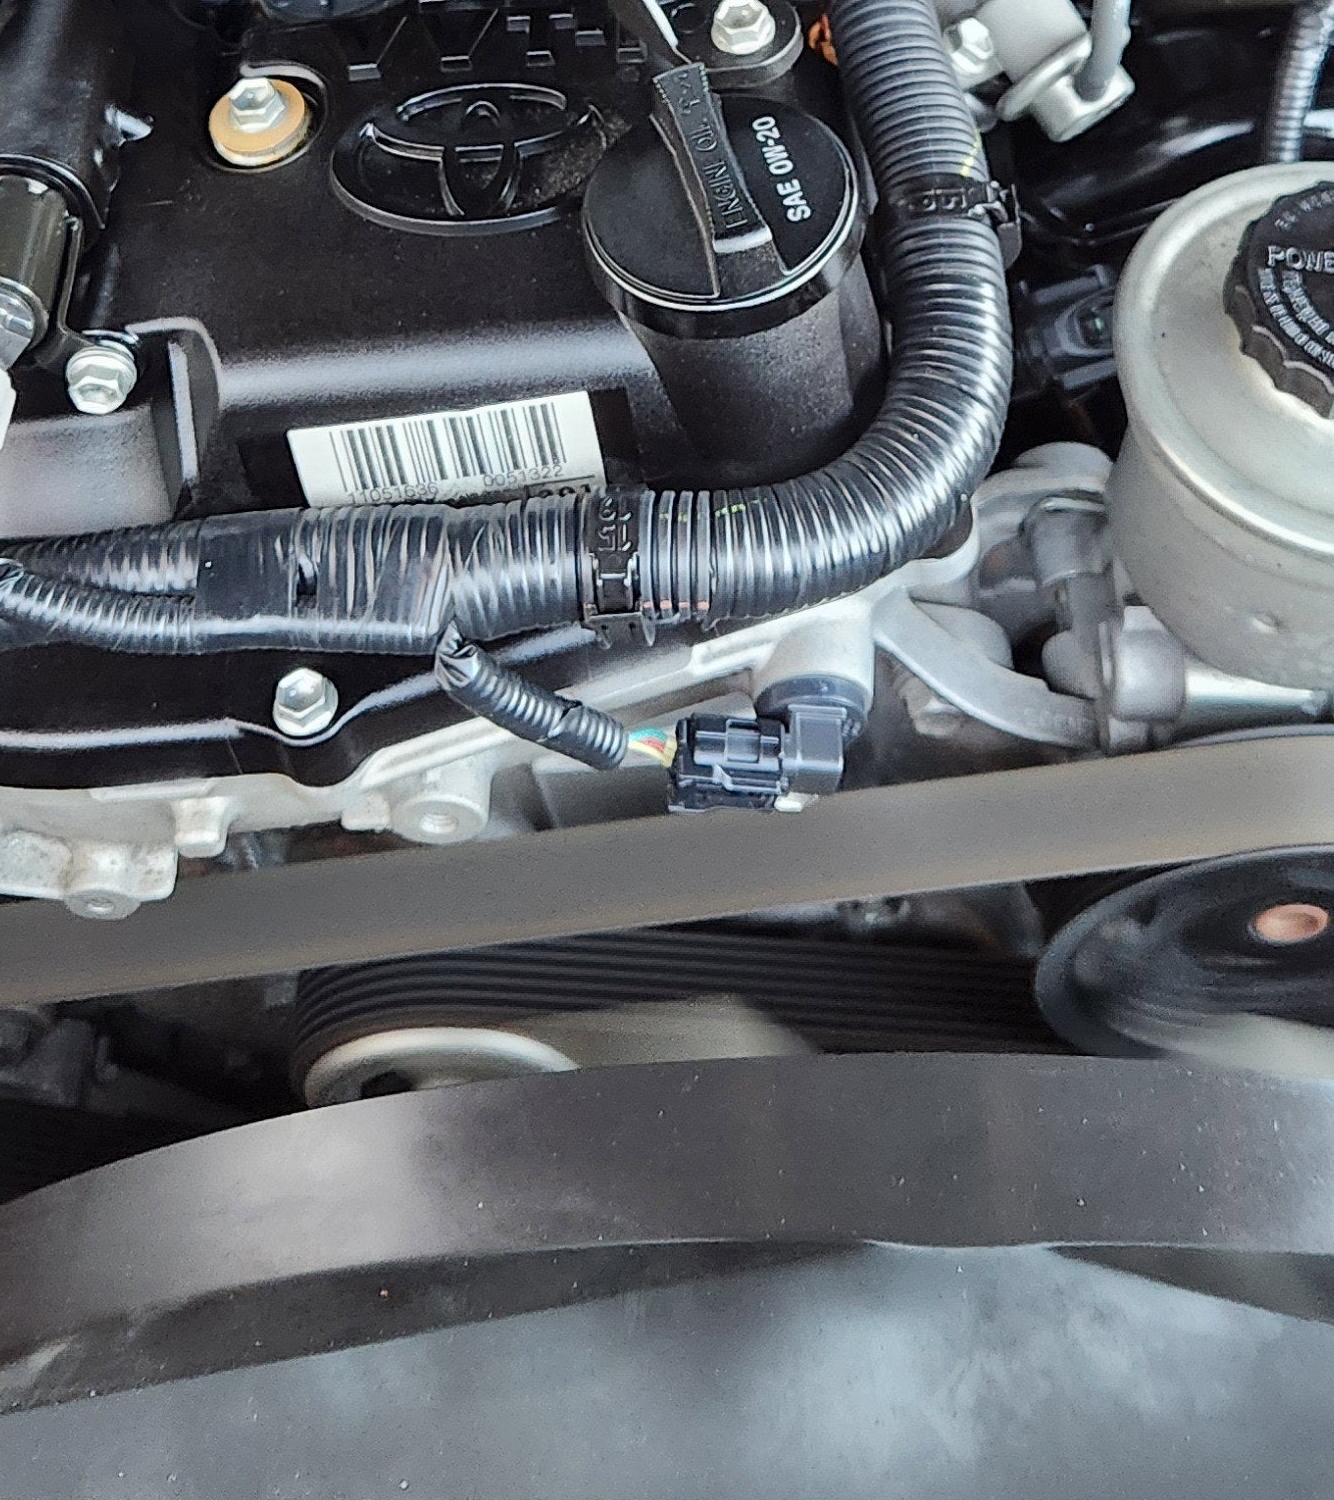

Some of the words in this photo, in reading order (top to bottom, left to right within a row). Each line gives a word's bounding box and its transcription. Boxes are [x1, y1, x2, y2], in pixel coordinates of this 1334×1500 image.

[751, 115, 795, 177] 0W-20
[776, 177, 812, 224] SAE
[482, 464, 565, 489] 0051322
